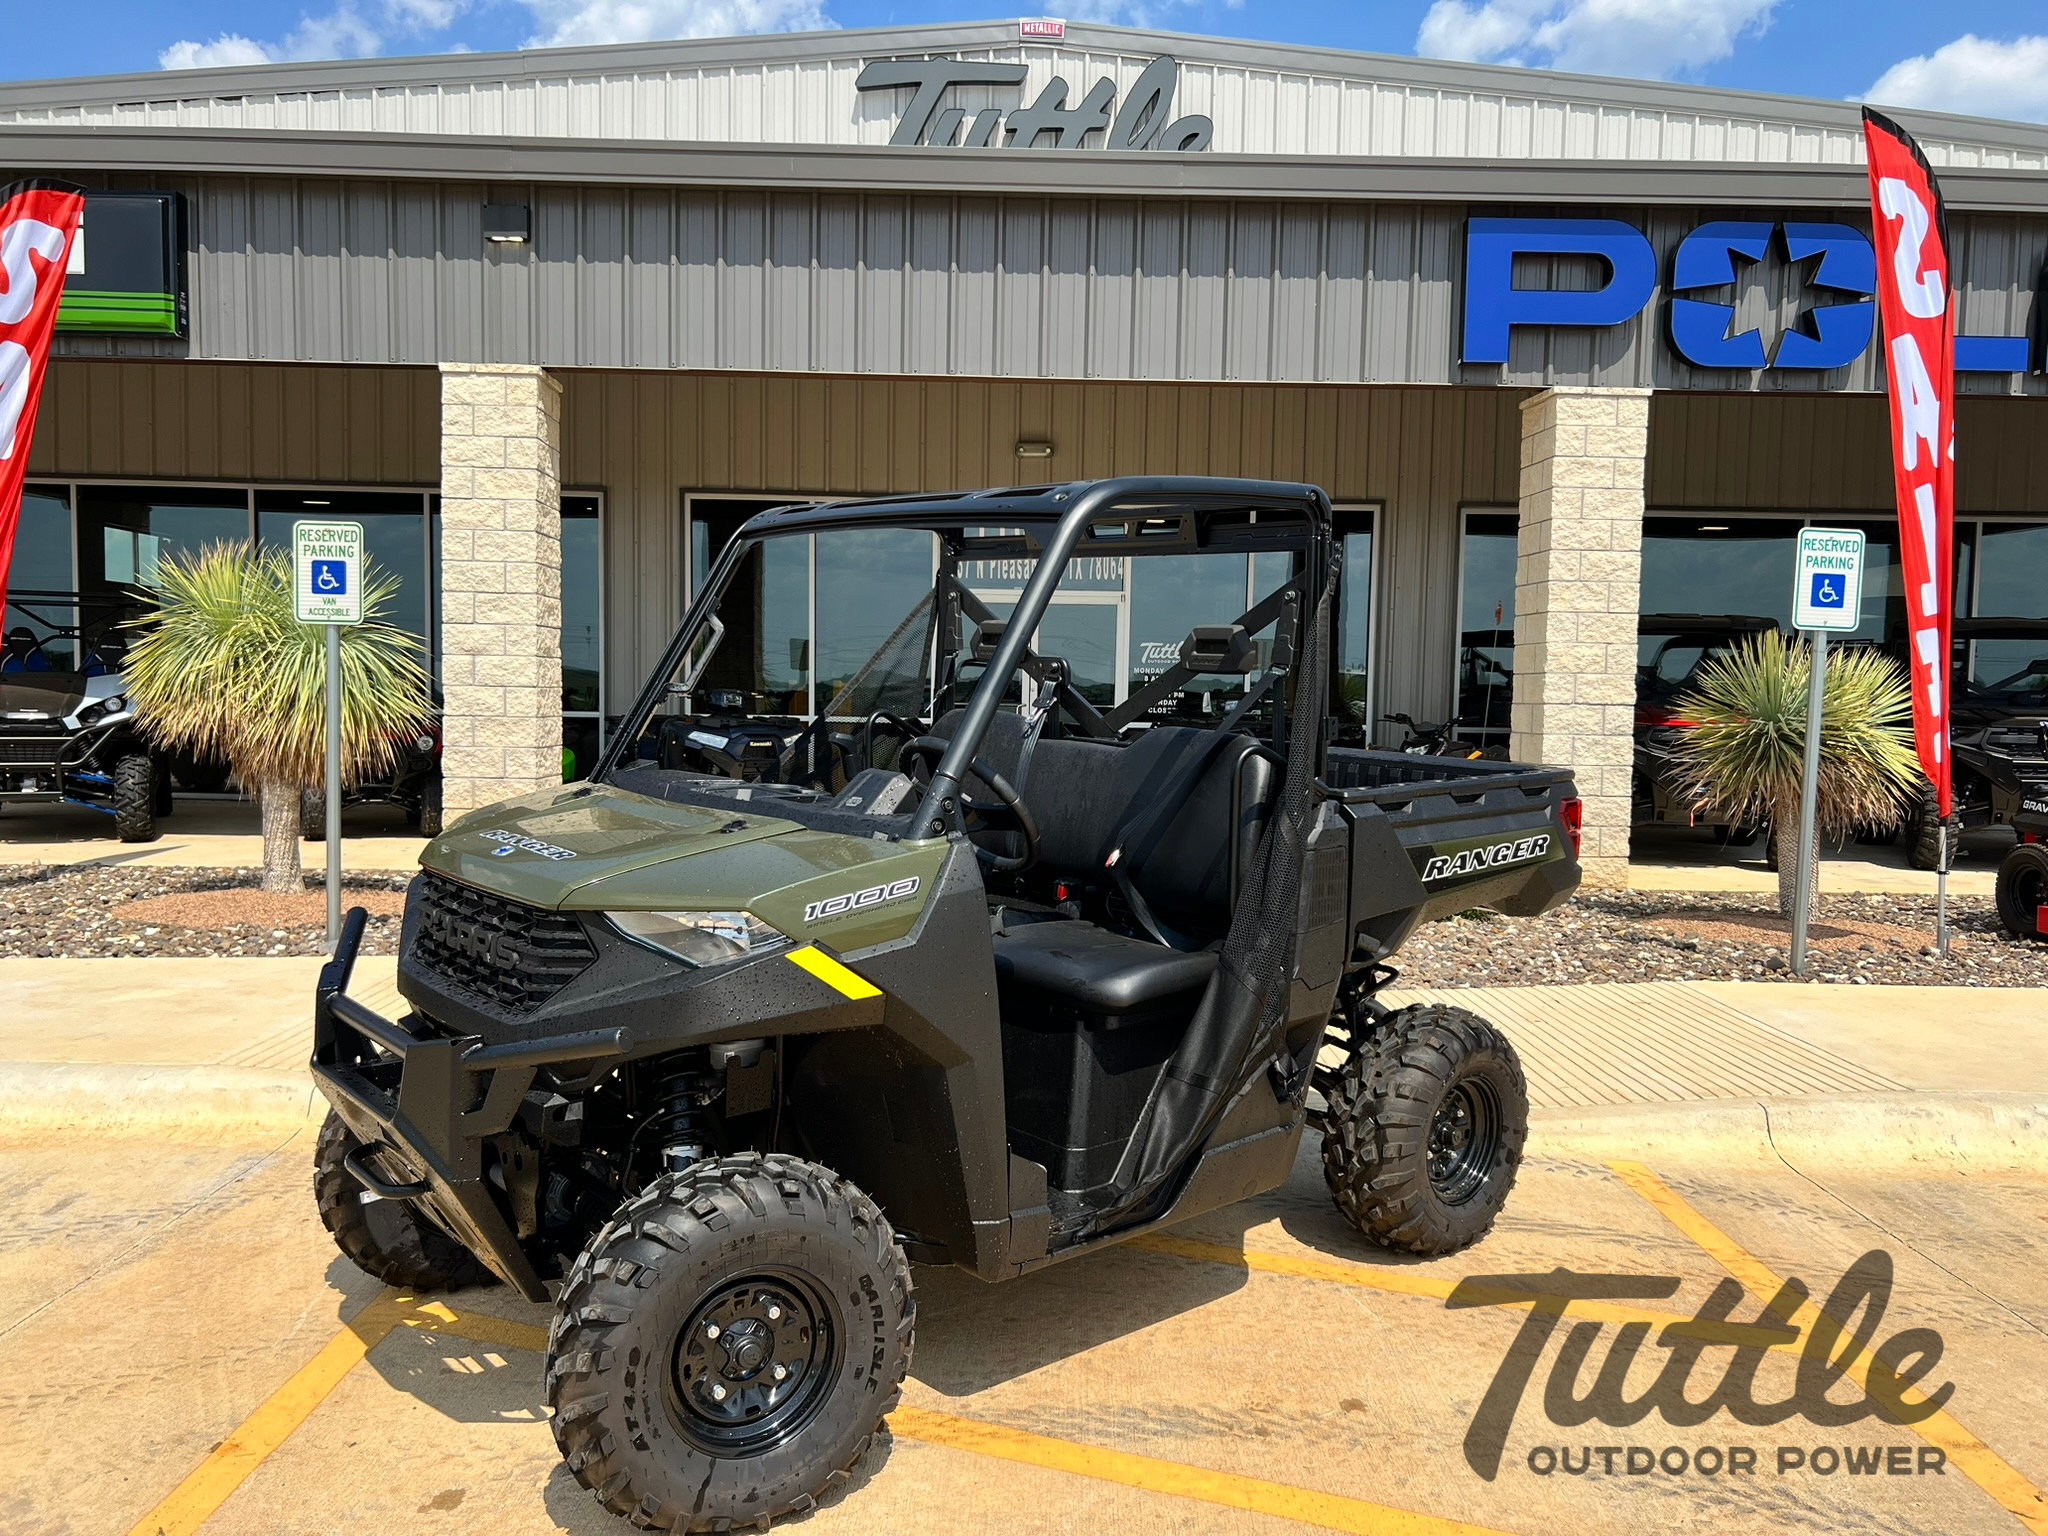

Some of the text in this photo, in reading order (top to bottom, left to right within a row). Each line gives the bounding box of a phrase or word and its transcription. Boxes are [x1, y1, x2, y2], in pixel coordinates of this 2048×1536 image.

[1024, 22, 1060, 34] METALLIC
[299, 529, 359, 543] RESERVED
[303, 544, 355, 558] PARKING
[1803, 538, 1860, 553] RESERVED
[1805, 555, 1854, 570] PARKING
[322, 597, 337, 606] VAN
[308, 607, 351, 617] ACCESSIBLE
[1140, 640, 1184, 664] Tuttl
[478, 829, 578, 861] RANGER
[1421, 834, 1550, 882] RANGER
[803, 876, 921, 922] 1000
